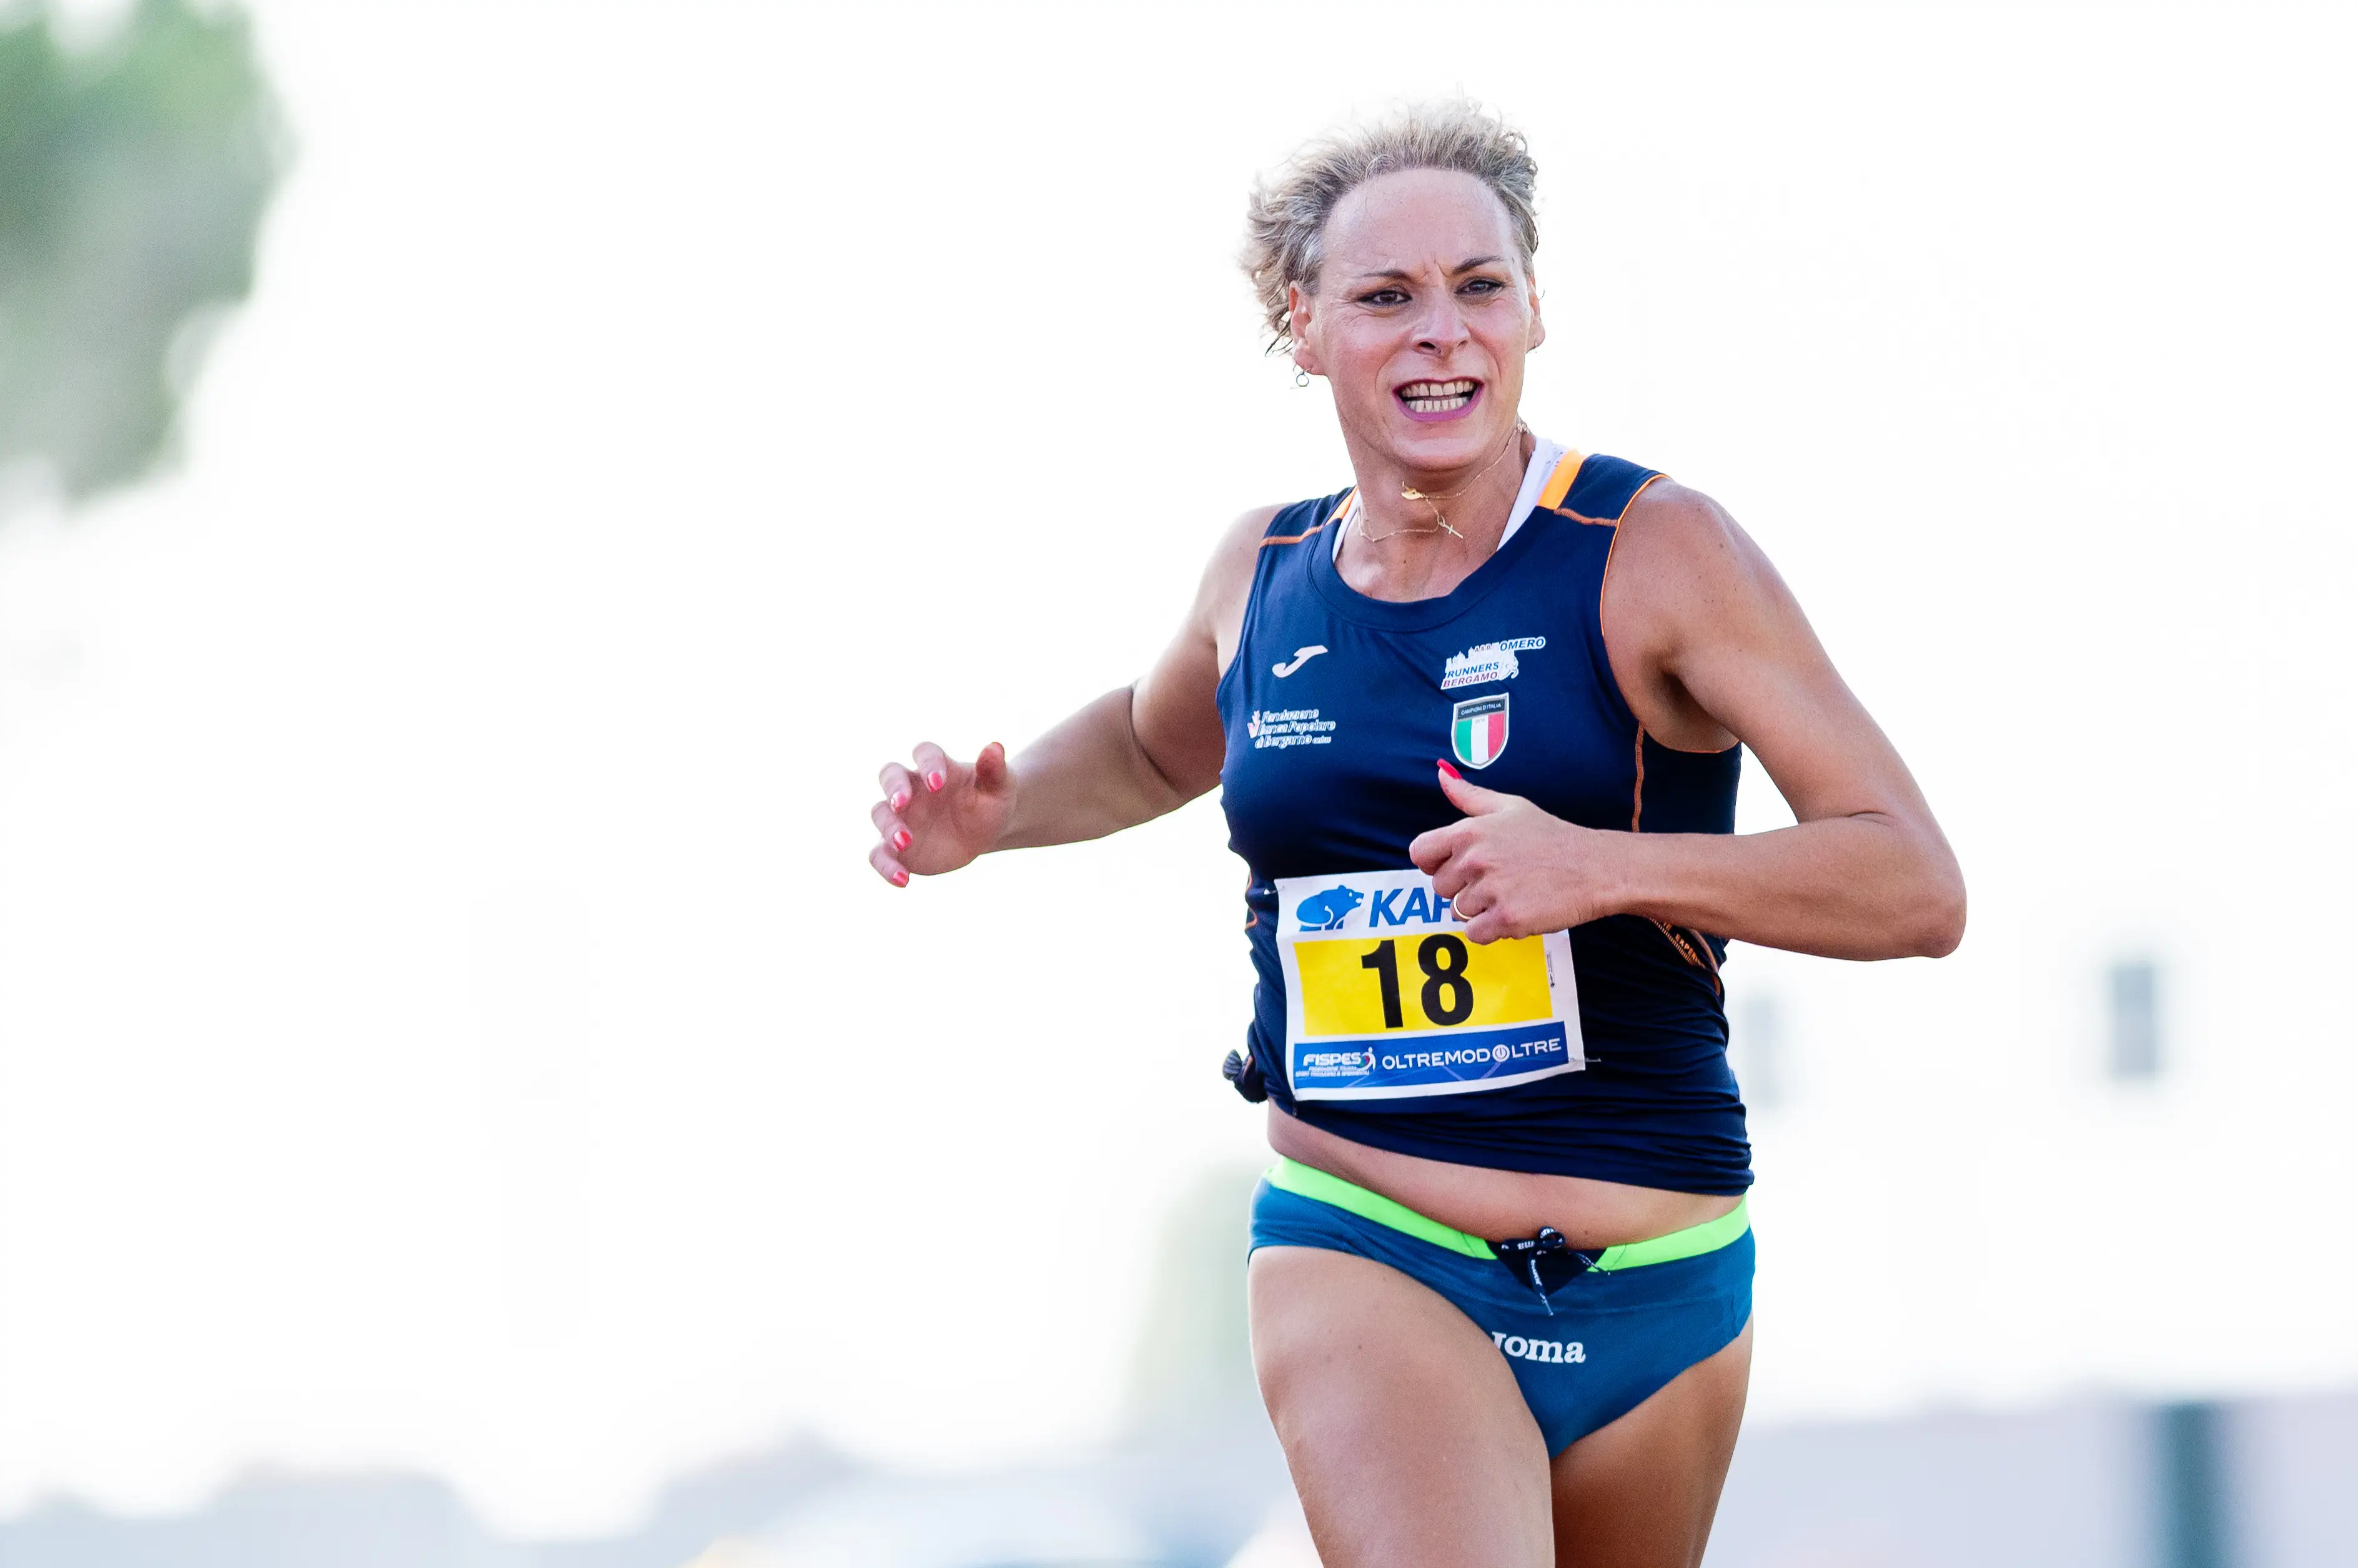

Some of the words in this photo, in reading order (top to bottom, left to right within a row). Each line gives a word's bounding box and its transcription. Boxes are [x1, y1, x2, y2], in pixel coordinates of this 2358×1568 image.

[1500, 638, 1545, 652] OMERO
[1447, 661, 1500, 679] RUNNERS
[1442, 671, 1499, 688] BERGAMO
[1361, 933, 1474, 1030] 18
[1302, 1052, 1362, 1067] FISPES
[1491, 1331, 1587, 1364] Joma
